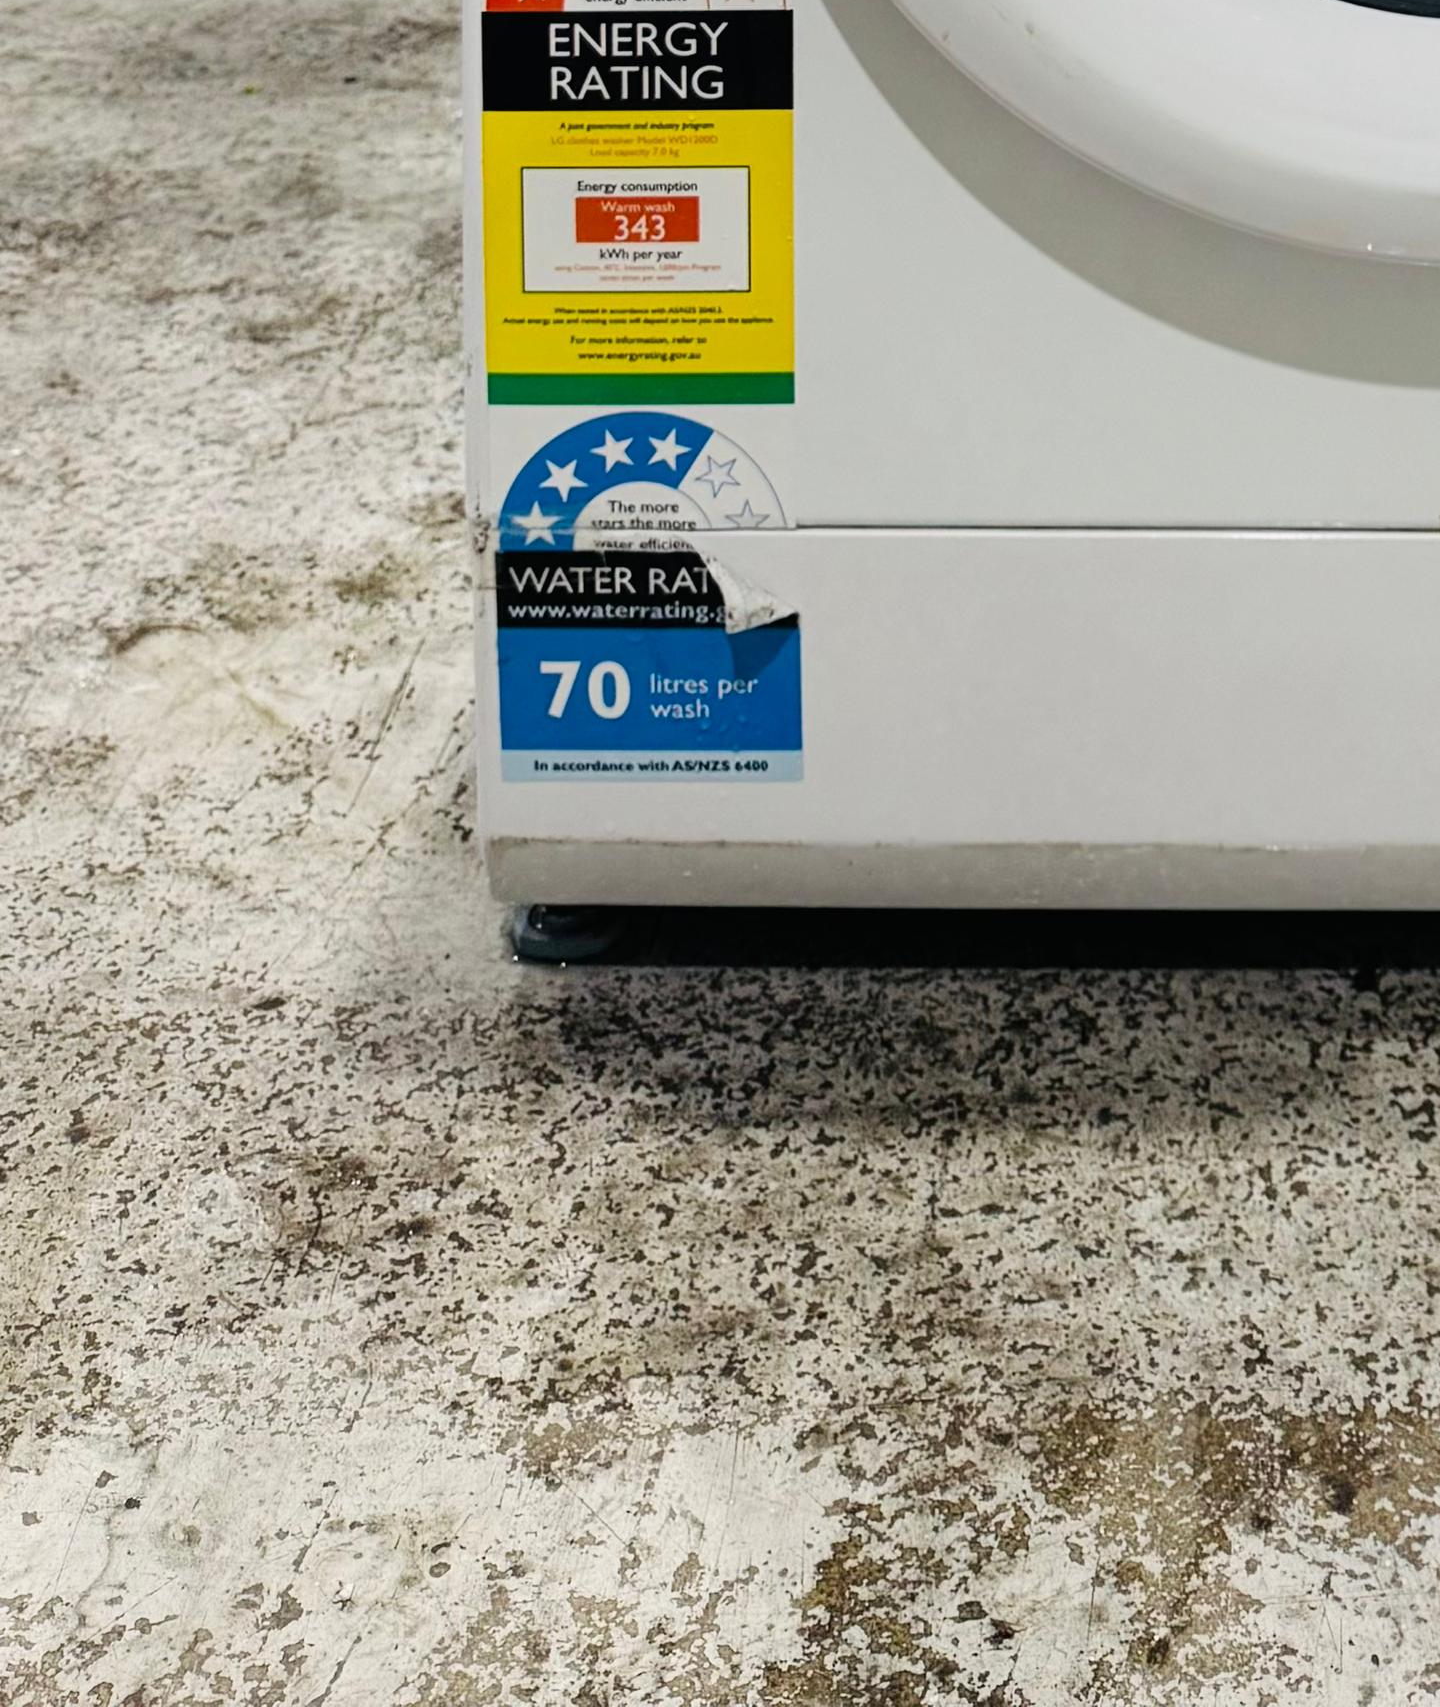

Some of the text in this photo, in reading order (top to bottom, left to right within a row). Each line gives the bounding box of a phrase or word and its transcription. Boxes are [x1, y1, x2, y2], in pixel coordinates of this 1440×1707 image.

[549, 22, 729, 58] ENERGY
[550, 65, 725, 100] RATING
[577, 180, 698, 194] Energy consumption
[601, 201, 675, 213] Warm wash
[614, 215, 666, 241] 343
[599, 248, 683, 262] kWh per year
[608, 500, 679, 514] The more
[630, 515, 654, 530] the
[658, 518, 696, 531] more
[509, 566, 637, 595] WATER
[539, 660, 759, 719] 70 litres per
[650, 698, 710, 719] wash
[533, 759, 769, 773] In accordance with AS/NZS 6400
